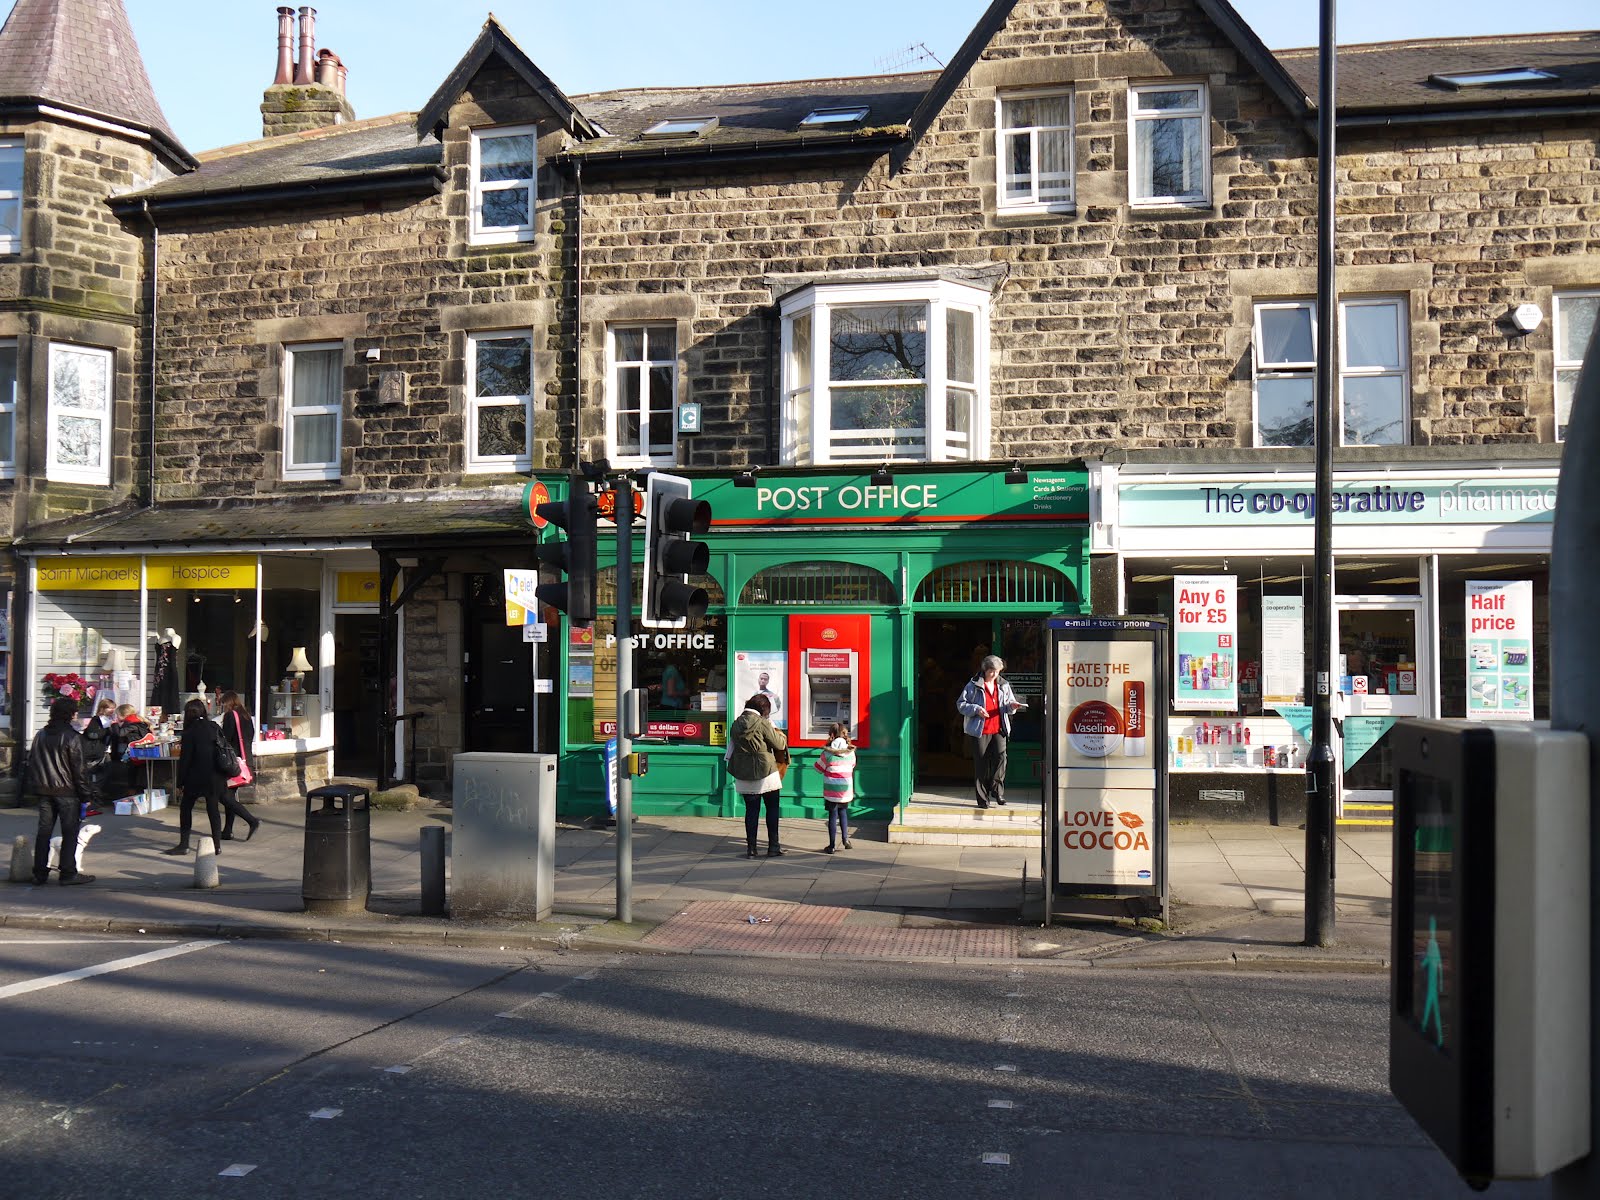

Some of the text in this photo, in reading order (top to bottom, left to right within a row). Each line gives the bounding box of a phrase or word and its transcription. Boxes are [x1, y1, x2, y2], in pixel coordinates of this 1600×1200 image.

[1033, 477, 1066, 485] Newsagents
[757, 484, 938, 511] POST OFFICE
[1200, 487, 1244, 513] The
[1439, 483, 1558, 517] pharmac
[39, 565, 230, 582] Saint Michael's Hospice
[1179, 588, 1226, 607] Any 6
[1471, 594, 1506, 610] Half
[1064, 619, 1091, 627] e-mail
[1099, 619, 1116, 627] text
[1179, 607, 1227, 624] for £5
[1471, 614, 1516, 633] price
[606, 633, 715, 649] PST OFFICE
[1066, 663, 1130, 674] HATE THE
[1066, 676, 1110, 687] COLD?
[1321, 673, 1326, 681] 1
[1320, 685, 1327, 693] 3
[1127, 689, 1137, 731] Vaseline
[658, 723, 679, 731] dollars
[1073, 722, 1116, 733] Vaseline
[1064, 810, 1114, 827] LOVE
[1064, 830, 1150, 850] COCOA
